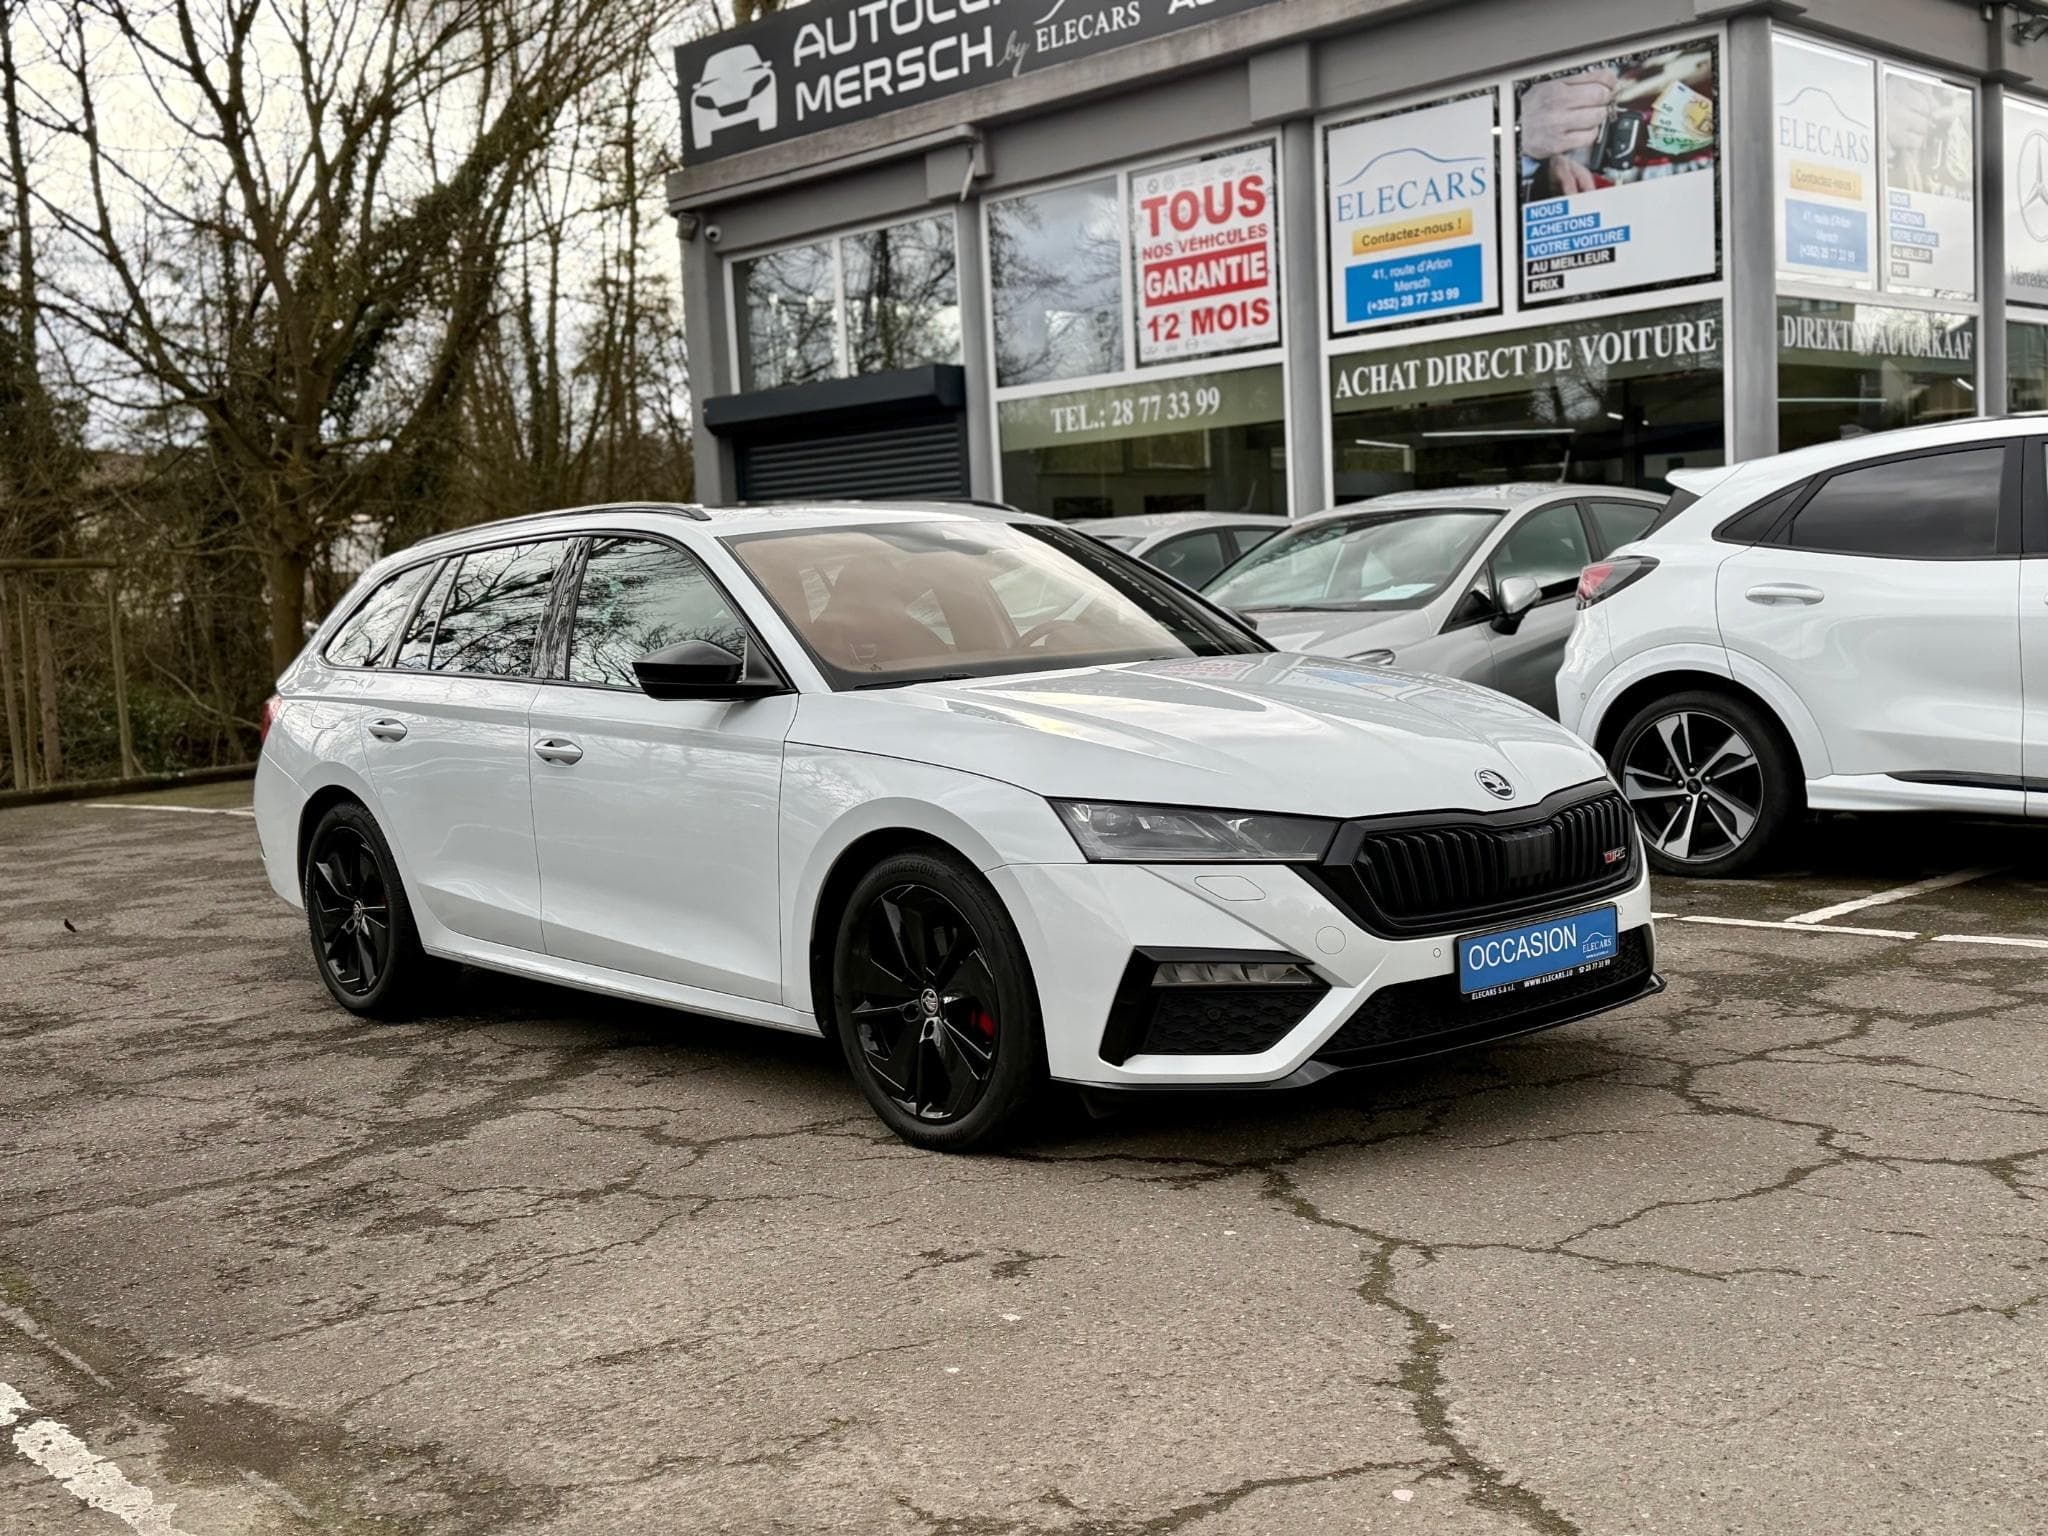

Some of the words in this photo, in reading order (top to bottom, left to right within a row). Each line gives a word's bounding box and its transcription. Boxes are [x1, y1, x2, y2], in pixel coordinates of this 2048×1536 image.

[794, 0, 1003, 67] AUTOC
[997, 30, 1029, 78] by
[1036, 1, 1141, 53] ELECARS
[795, 25, 994, 121] MERSCH
[1778, 116, 1869, 164] ELECARS
[1140, 174, 1266, 237] TOUS
[1336, 167, 1487, 222] ELECARS
[1530, 203, 1563, 218] NOUS
[1362, 222, 1454, 247] Contactez-nous
[1458, 218, 1462, 229] !
[1531, 216, 1594, 238] ACHETONS
[1531, 240, 1571, 256] VOTRE
[1572, 229, 1624, 248] VOITURE
[1142, 242, 1173, 260] NOS
[1531, 261, 1548, 275] AU
[1550, 250, 1610, 270] MEILLEUR
[1145, 250, 1266, 299] GARANTIE
[1372, 268, 1388, 281] 41,
[1390, 264, 1415, 278] route
[1393, 276, 1431, 292] Mersch
[1532, 278, 1559, 293] PRIX
[1367, 298, 1399, 314] (+352)
[1401, 294, 1414, 307] 28
[1415, 292, 1429, 305] 77
[1431, 290, 1445, 303] 33
[1446, 287, 1460, 299] 99
[1147, 313, 1180, 342] 12
[1190, 297, 1270, 337] MOIS
[1335, 359, 1421, 399] ACHAT
[1426, 344, 1528, 388] DIRECT
[1534, 338, 1571, 373] DE
[1578, 319, 1718, 367] VOITURE
[1111, 399, 1134, 427] 28
[1138, 395, 1162, 423] 77
[1166, 391, 1190, 420] 33
[1196, 387, 1221, 416] 99
[1468, 923, 1577, 971] OCCASION
[1582, 938, 1612, 953] ELECARS
[1471, 986, 1497, 1000] ELECARS
[1523, 969, 1574, 988] WWW.ELECARS.LU
